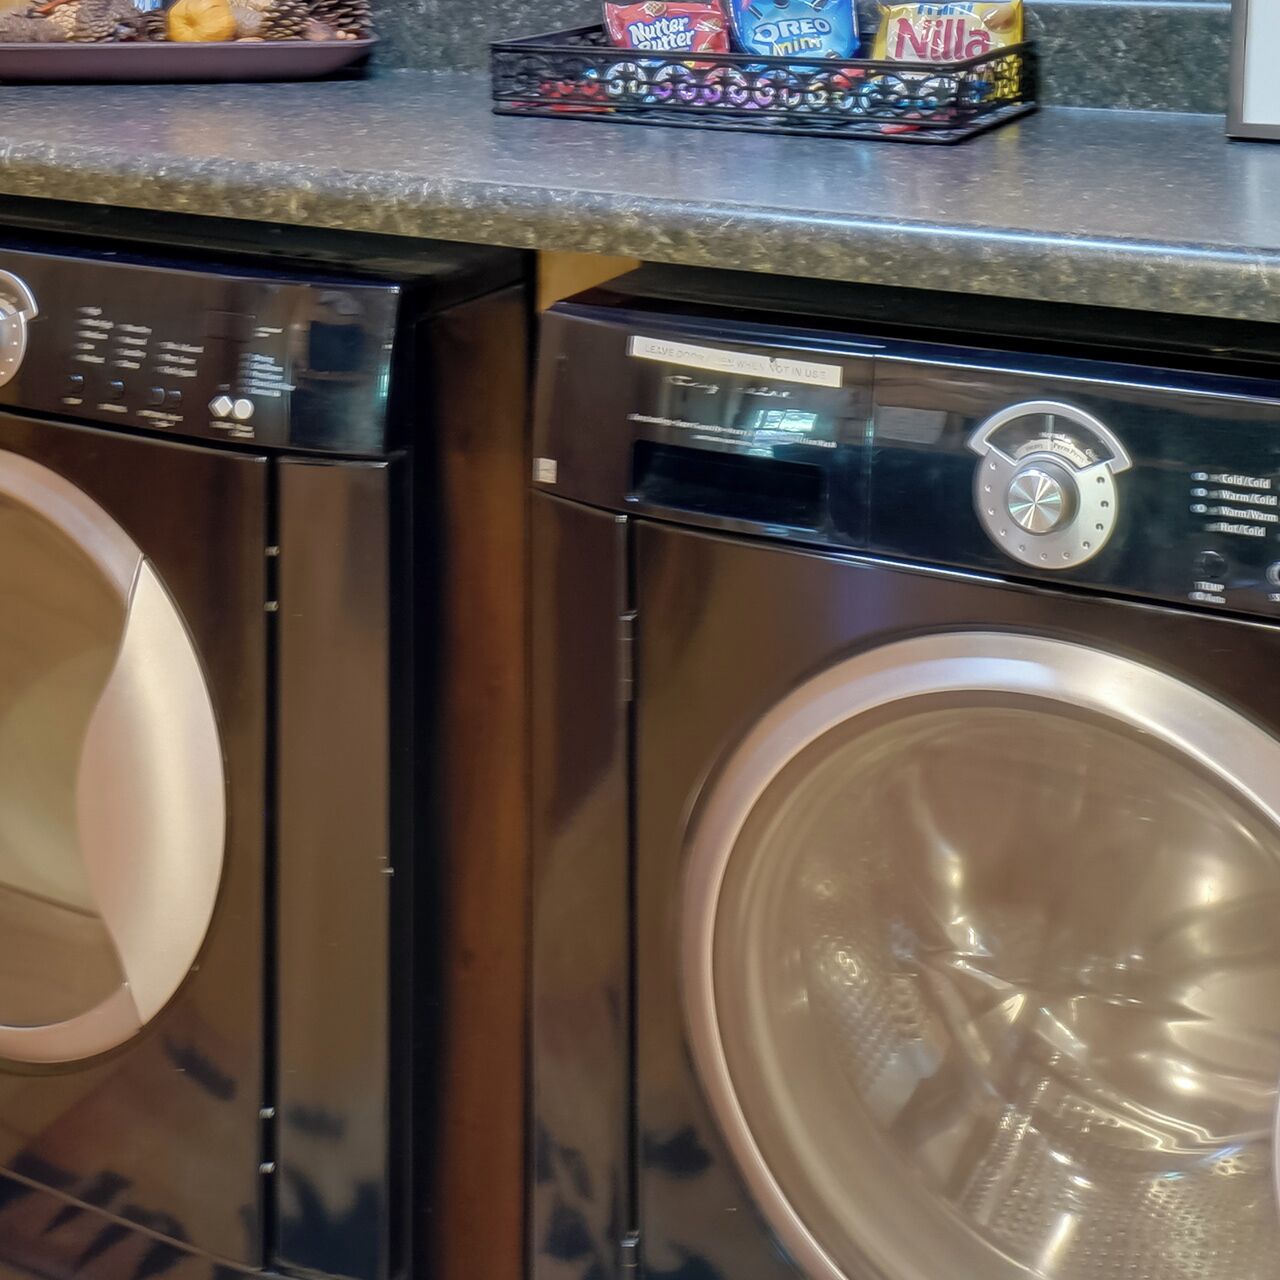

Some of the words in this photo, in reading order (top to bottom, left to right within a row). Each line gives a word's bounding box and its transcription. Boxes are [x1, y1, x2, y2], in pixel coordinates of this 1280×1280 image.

[628, 17, 690, 45] Nutter
[754, 20, 831, 43] OREO
[896, 17, 991, 61] Nilla
[645, 344, 674, 358] LEAVE
[792, 367, 802, 376] IN
[804, 368, 827, 380] USE
[1221, 474, 1271, 489] Cold/Cold
[1220, 490, 1278, 506] Warm/Cold
[1220, 506, 1278, 522] Warm/Warm
[1220, 522, 1267, 536] Hot/Cold
